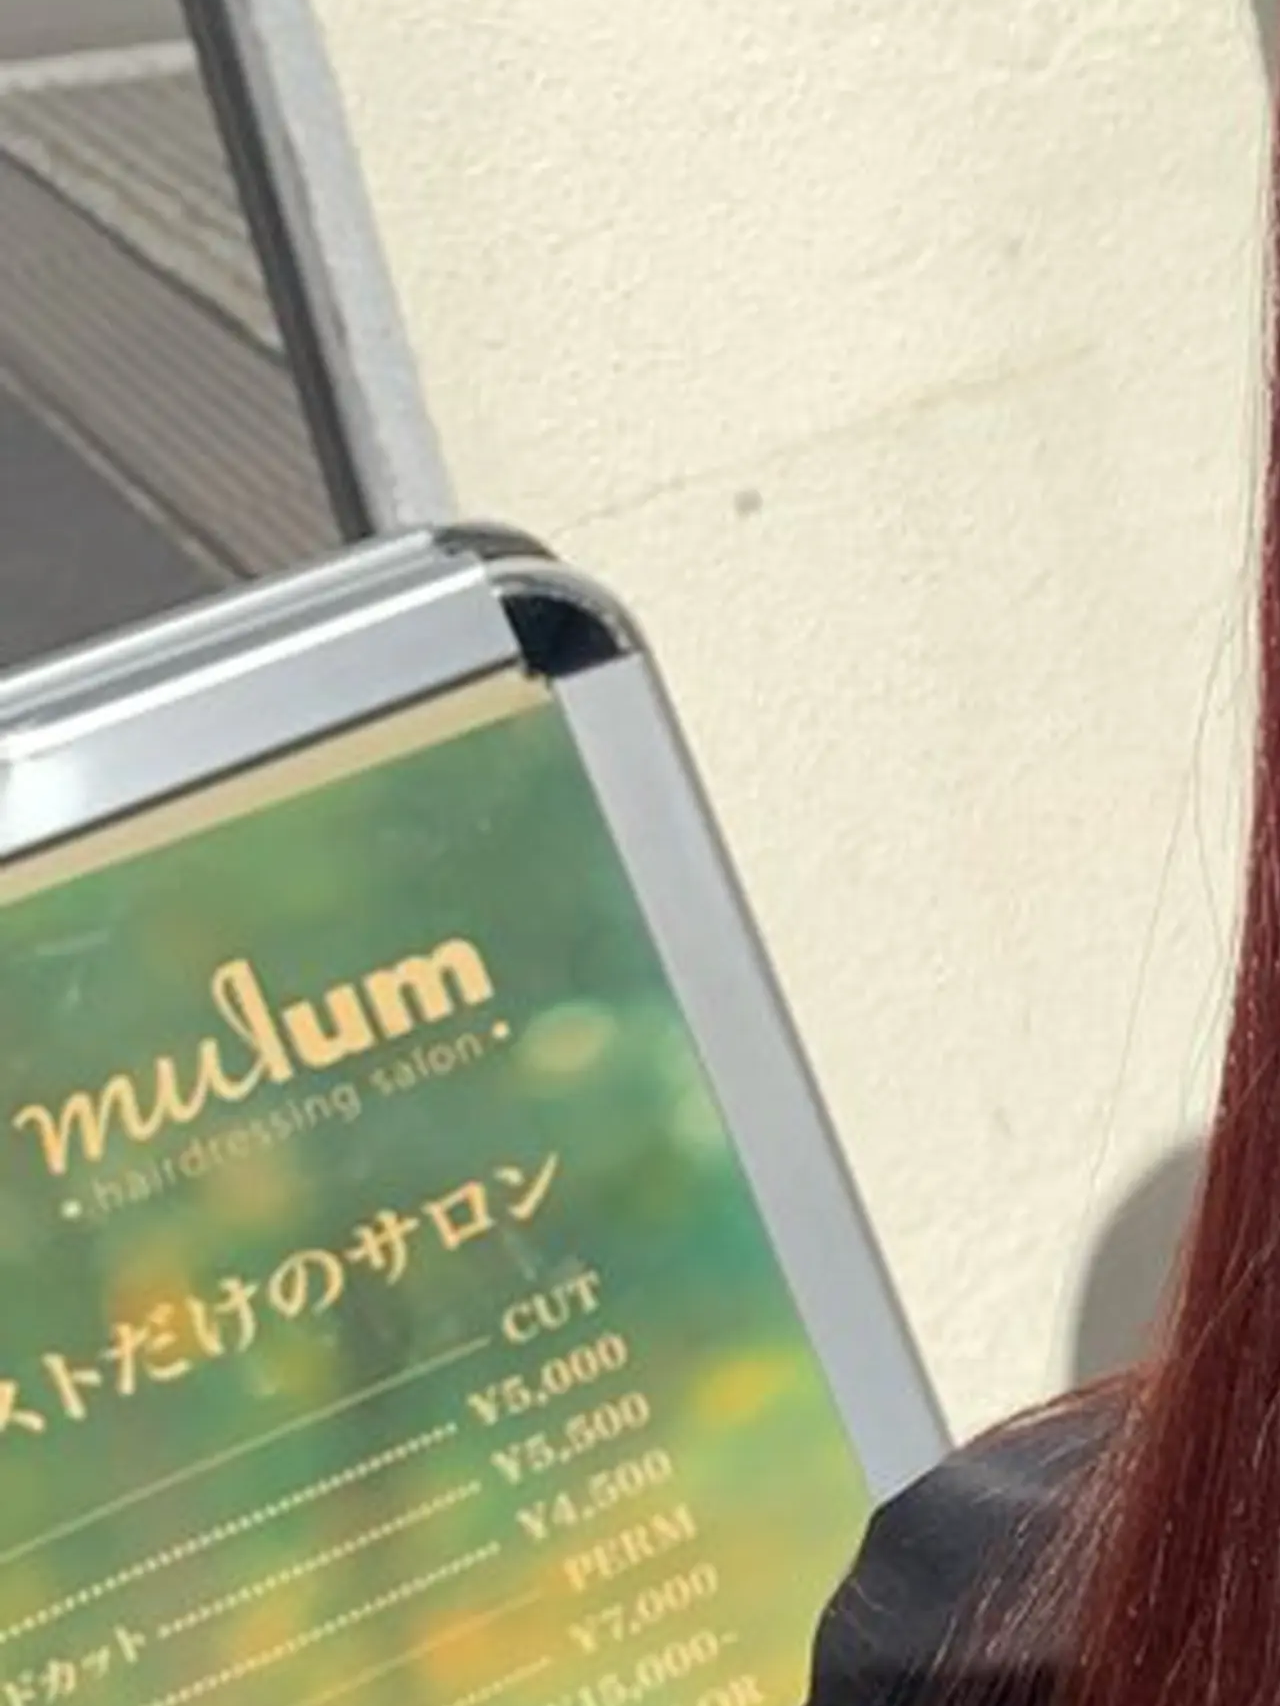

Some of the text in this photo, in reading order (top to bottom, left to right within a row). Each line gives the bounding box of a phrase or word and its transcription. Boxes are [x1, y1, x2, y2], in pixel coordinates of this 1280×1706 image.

[13, 938, 493, 1175] mulum
[90, 1029, 484, 1215] hairdressing salon
[502, 1270, 600, 1344] CUT
[563, 1512, 697, 1591] PERM
